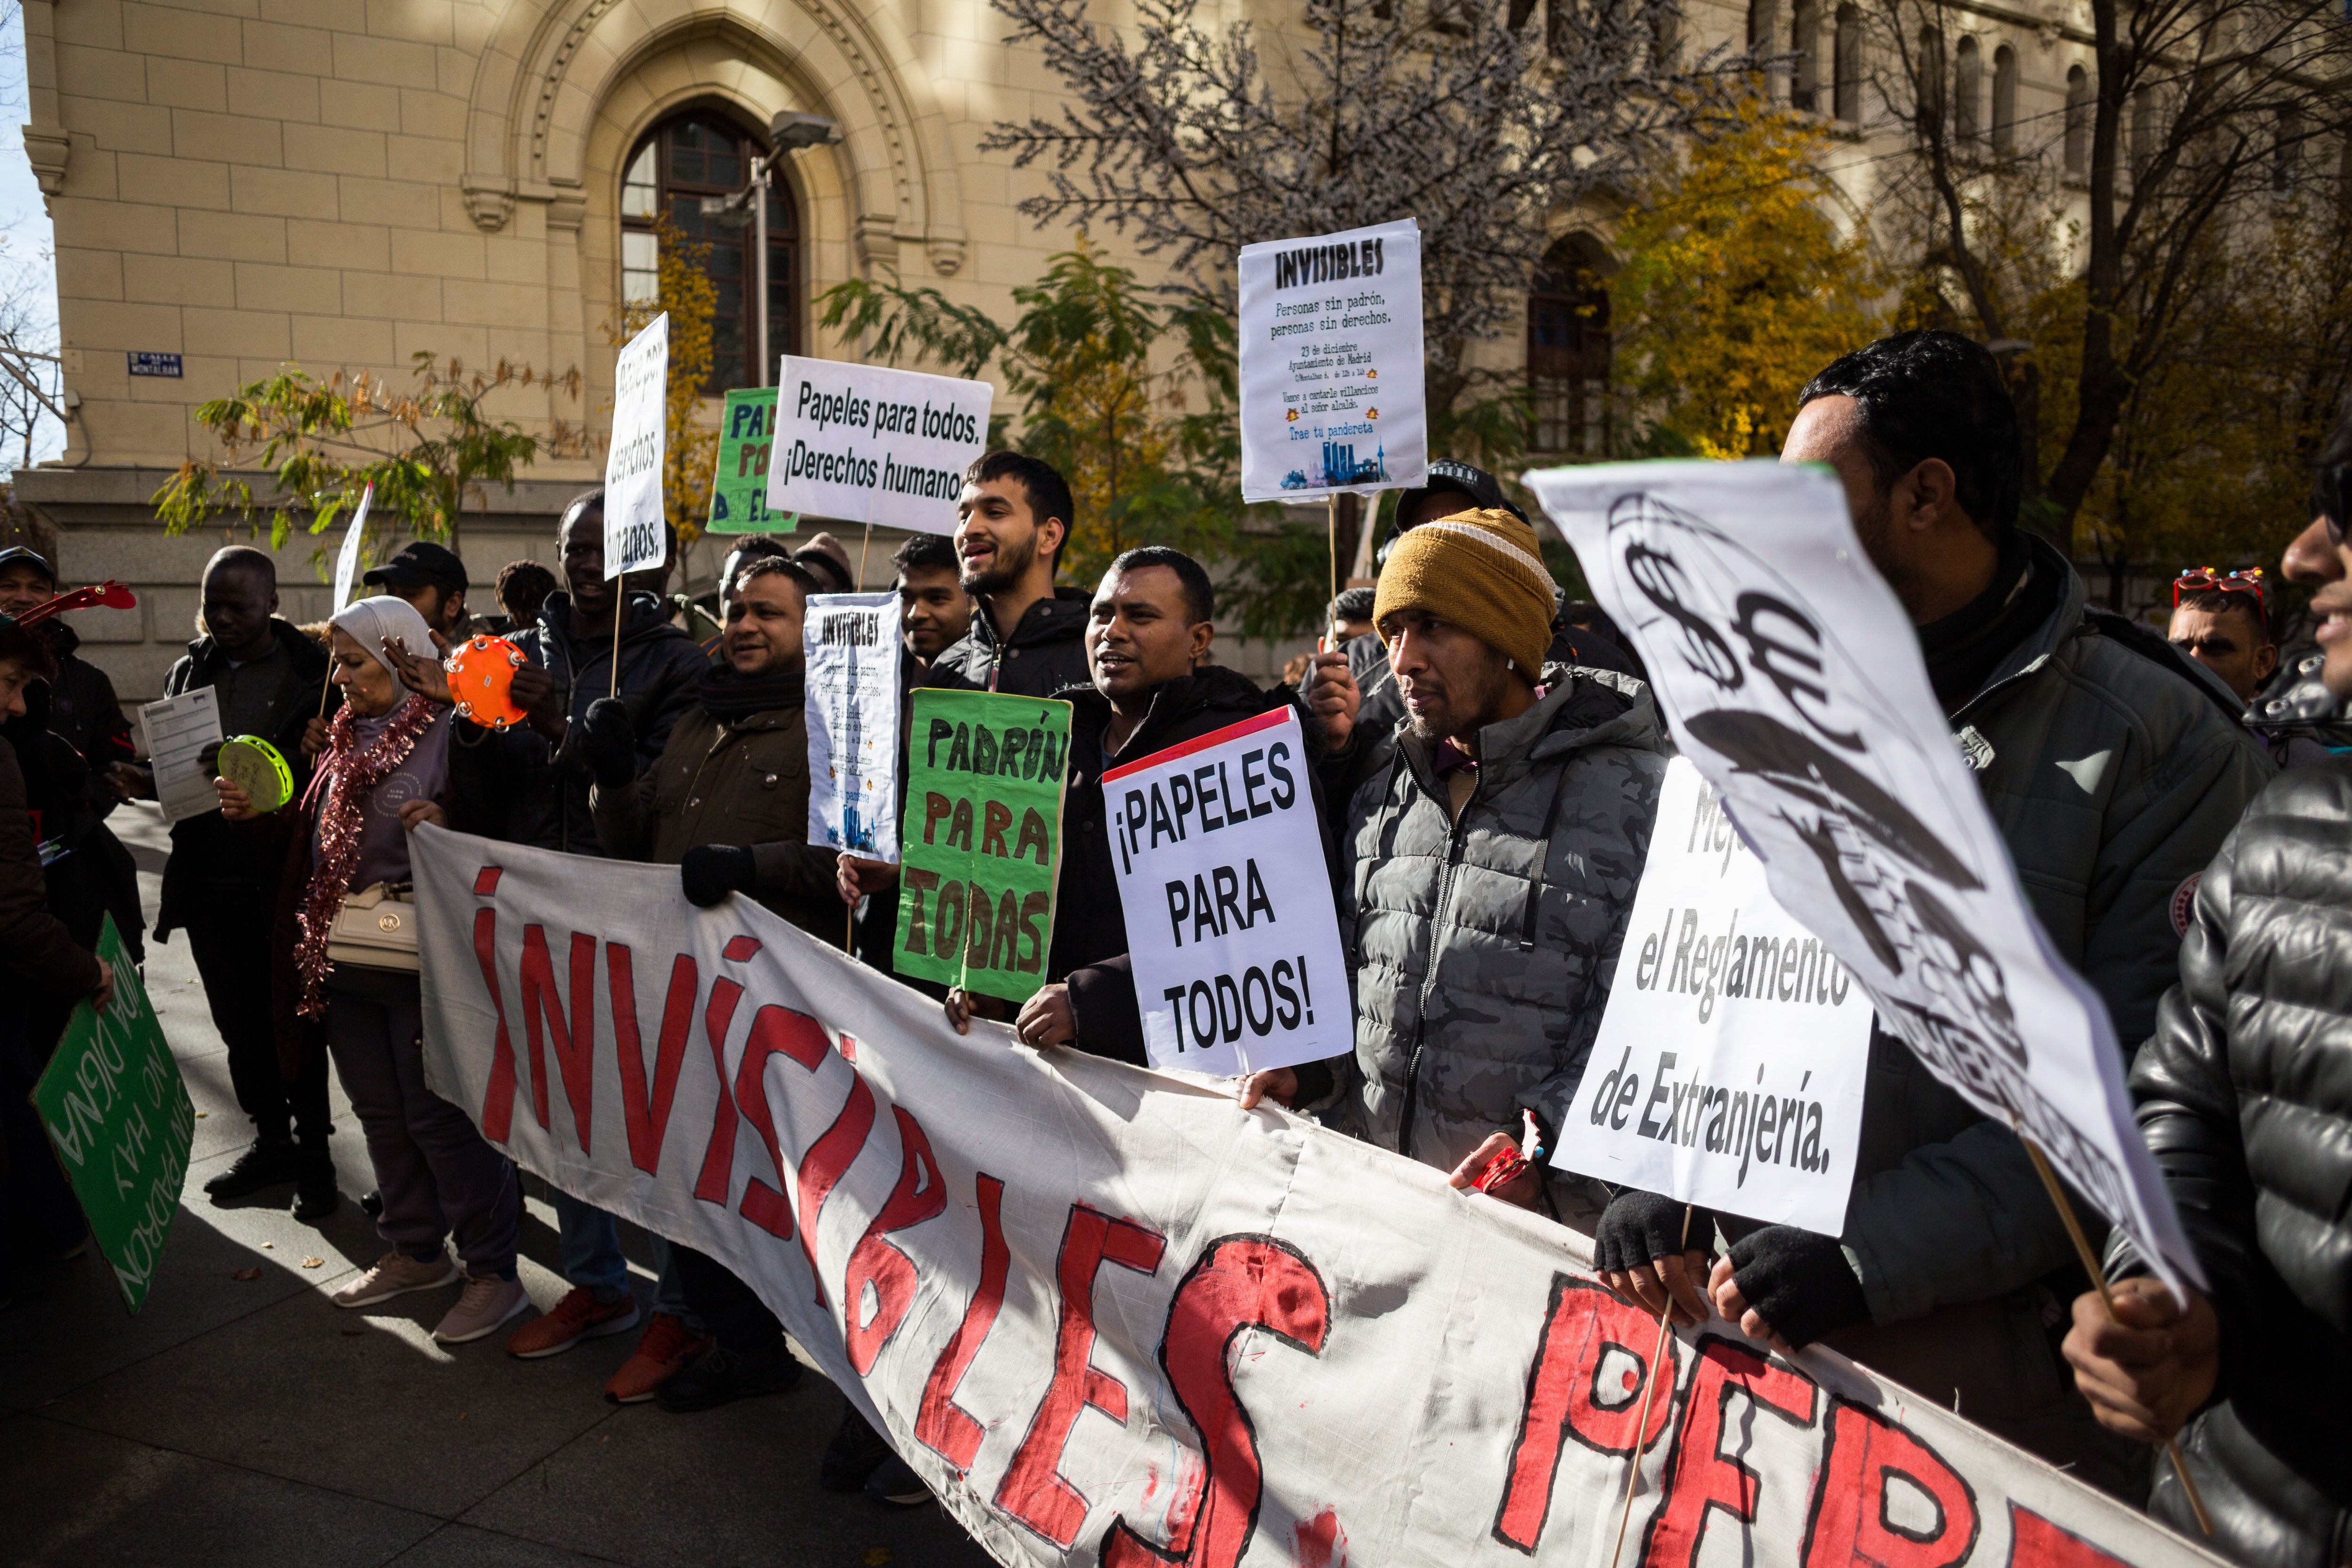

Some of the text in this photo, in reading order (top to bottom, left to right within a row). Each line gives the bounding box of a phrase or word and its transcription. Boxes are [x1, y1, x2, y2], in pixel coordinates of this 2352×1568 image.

[1275, 237, 1384, 290] INVISIBLES
[1271, 310, 1391, 340] personas sin derechos.
[1275, 291, 1385, 317] Personas sin padrón,
[1288, 352, 1372, 372] Ayuntamiento de Madrid
[1301, 342, 1358, 357] 23 de diciembre
[797, 380, 980, 446] Papeles para todos.
[1282, 392, 1300, 403] Vamos
[1309, 388, 1337, 400] cantarle
[1340, 385, 1379, 397] villancicos
[1301, 399, 1358, 413] al señor alcalde.
[738, 442, 771, 479] PO
[1289, 422, 1373, 440] Trae tu pandereta
[784, 439, 961, 501] ¡Derechos humano
[927, 709, 1069, 784] PADRÓN
[922, 791, 1049, 866] PARA
[1114, 741, 1296, 876] ¡PAPELES
[903, 866, 1050, 977] TODAS
[1164, 858, 1277, 948] PARA
[1636, 907, 1850, 1026] el Reglamento
[1162, 955, 1315, 1053] TODOS!
[111, 1038, 168, 1203] NO HAY
[1589, 1045, 1639, 1132] de
[1636, 1050, 1830, 1190] Extranjería.
